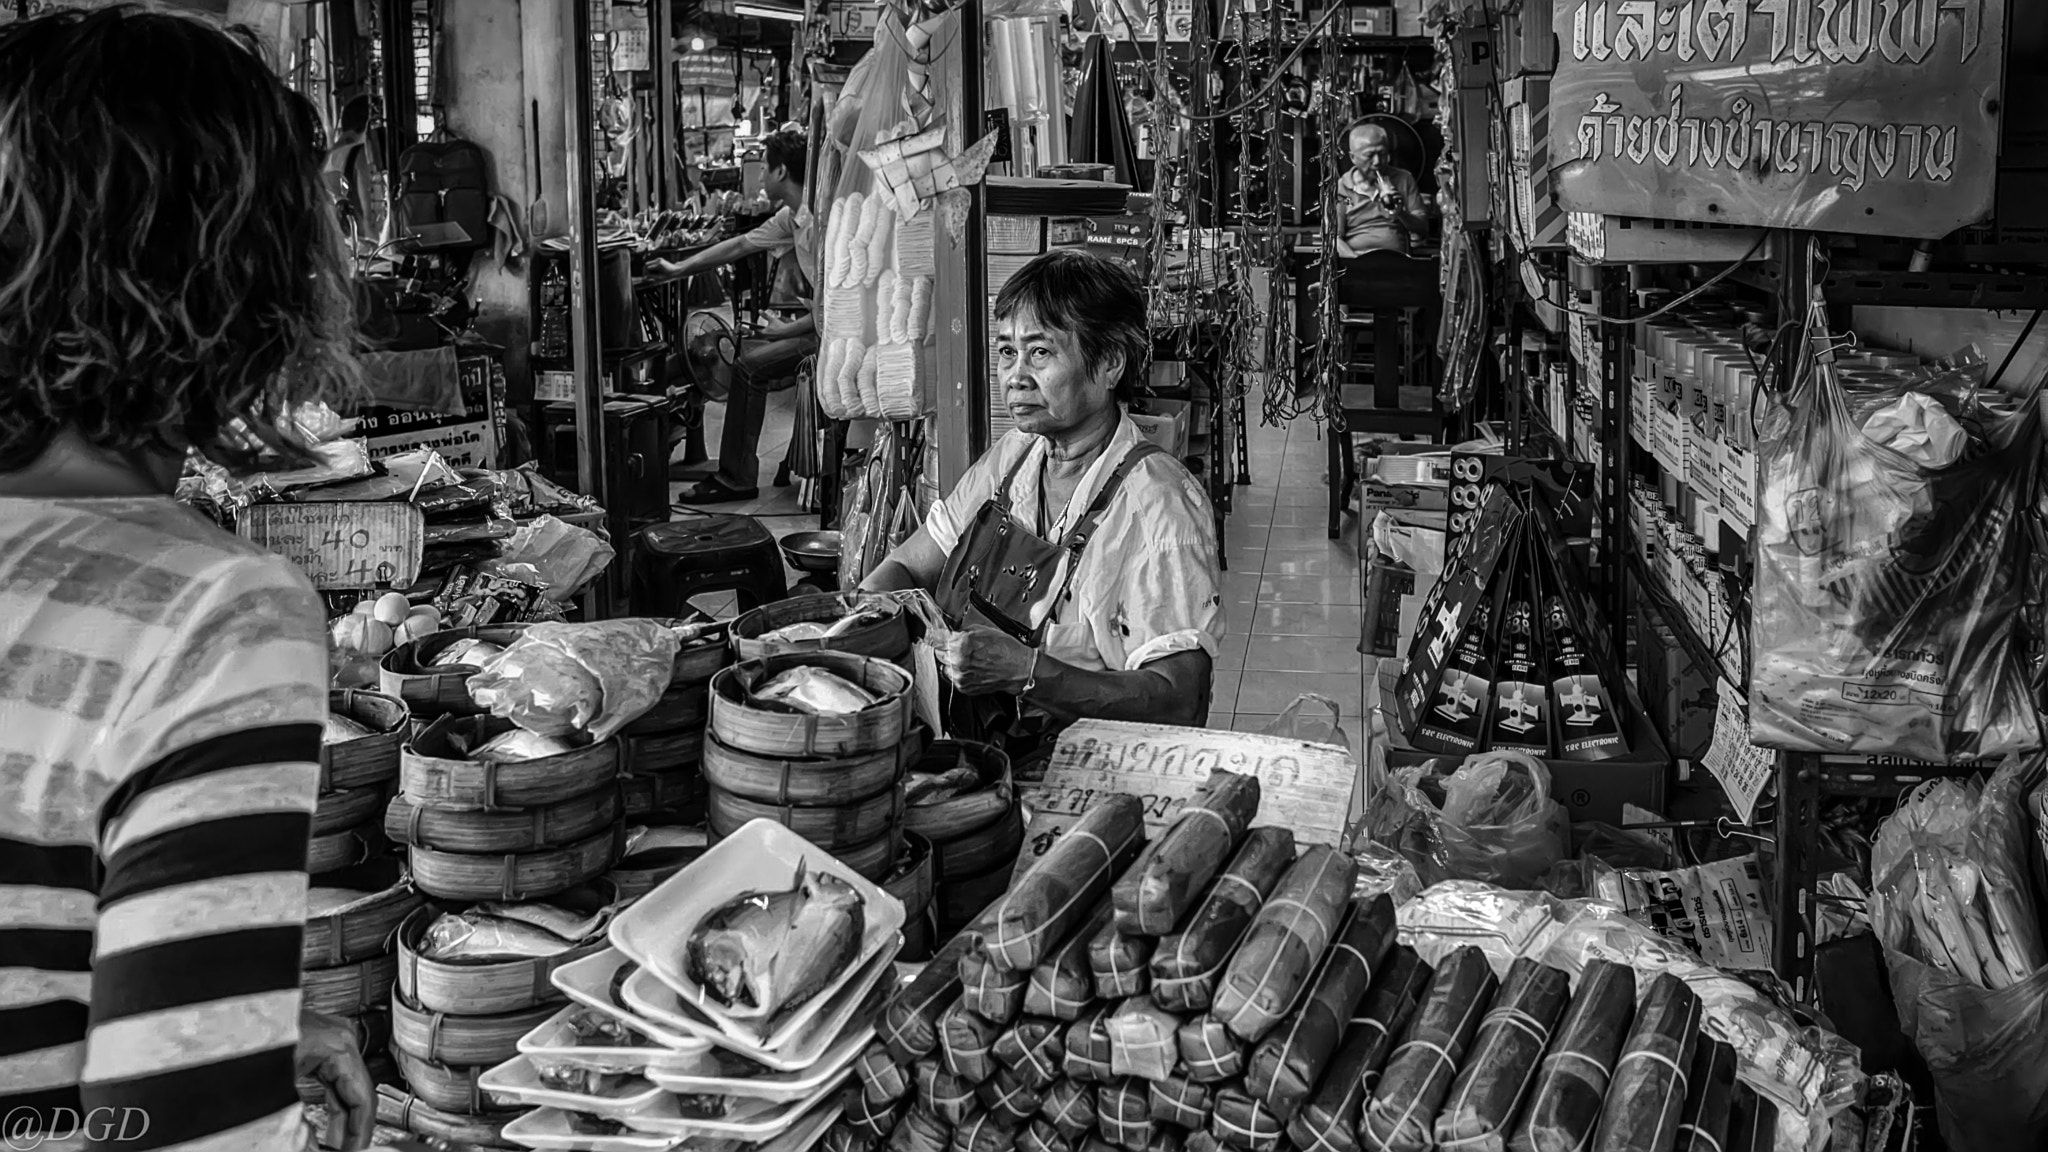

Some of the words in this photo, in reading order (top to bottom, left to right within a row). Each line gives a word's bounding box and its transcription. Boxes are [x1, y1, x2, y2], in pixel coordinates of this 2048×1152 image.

[321, 528, 370, 550] 40
[1863, 688, 1897, 701] 12x20
[1581, 736, 1619, 750] ELECTRONIC
